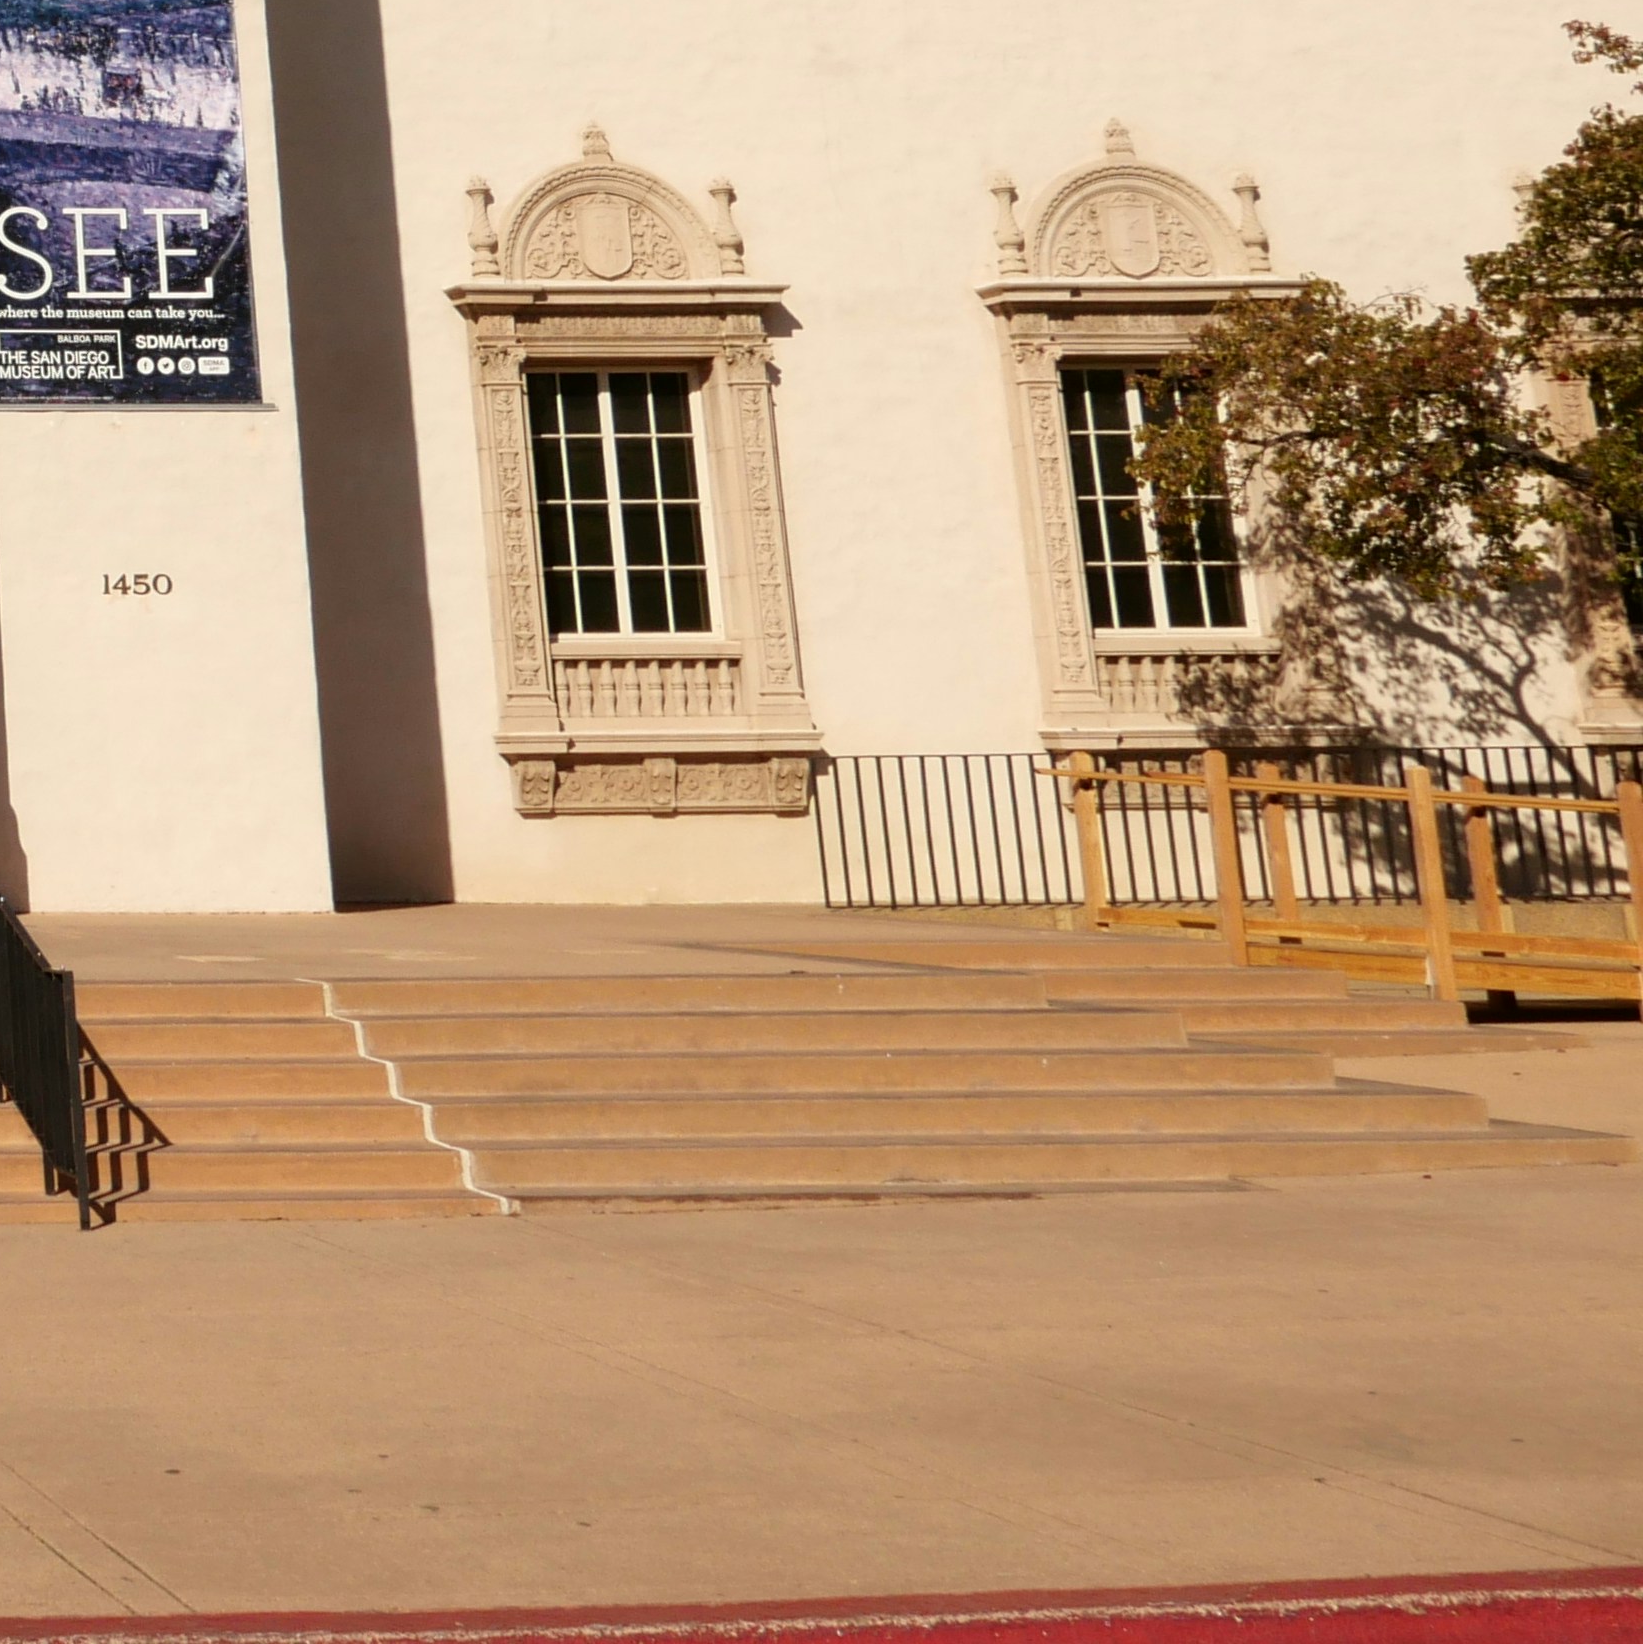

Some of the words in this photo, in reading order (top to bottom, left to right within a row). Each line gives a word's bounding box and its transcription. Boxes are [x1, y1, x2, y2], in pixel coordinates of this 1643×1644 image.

[41, 305, 64, 318] the
[66, 309, 125, 318] museum
[127, 309, 153, 318] can
[155, 305, 185, 318] take
[57, 335, 91, 344] BALBOA
[93, 335, 116, 344] PARK
[135, 335, 229, 352] SDMArt.org
[0, 351, 28, 365] THE
[31, 351, 61, 365] SAN
[64, 351, 110, 365] DIEGO
[0, 366, 64, 379] MUSEUM
[66, 366, 86, 379] OF
[87, 366, 116, 379] ART
[102, 573, 173, 595] 1450
